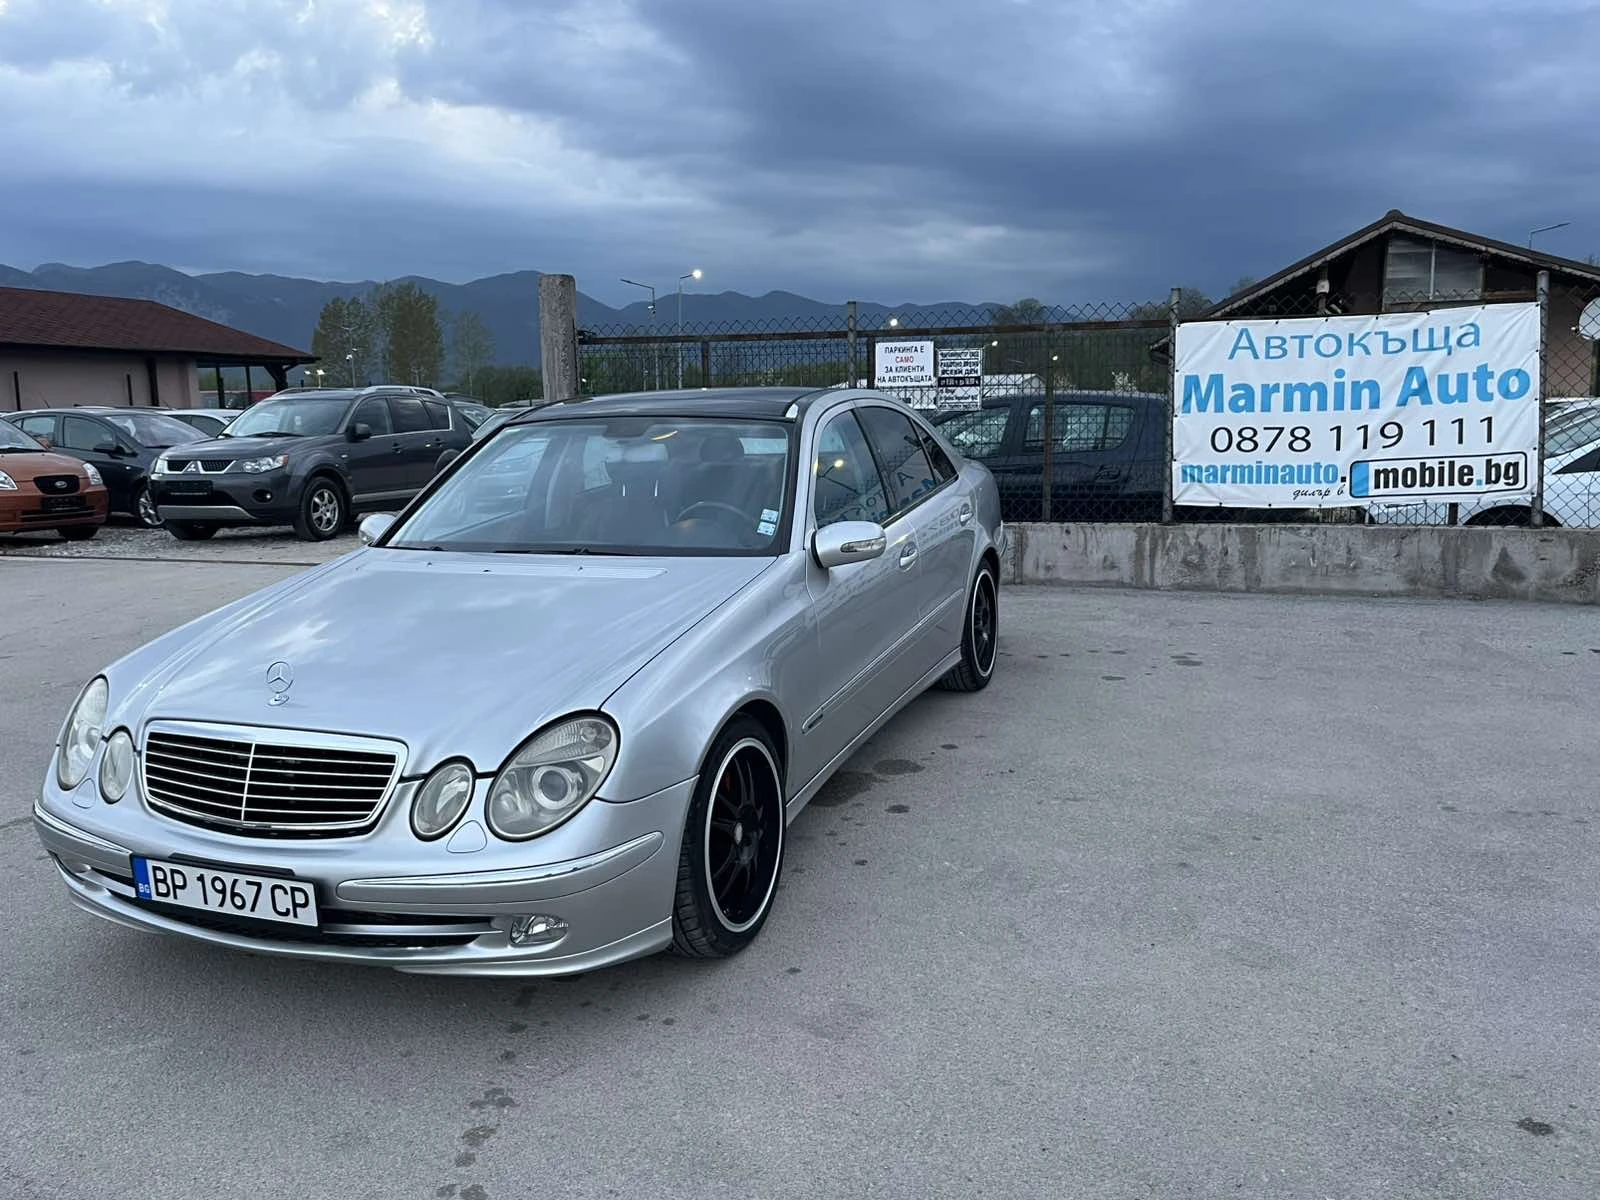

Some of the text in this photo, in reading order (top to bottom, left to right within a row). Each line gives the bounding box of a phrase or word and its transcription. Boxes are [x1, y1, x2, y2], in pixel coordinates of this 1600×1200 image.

[885, 345, 925, 354] ПАРКИНГА Е
[1228, 322, 1481, 360] Автокъща
[884, 365, 925, 374] ЗА КЛИЕНТИ
[895, 356, 914, 364] САМО
[1182, 362, 1531, 414] Marmin Auto
[1210, 416, 1493, 453] 0878 119 111
[1374, 458, 1520, 490] mobile.bg
[1292, 487, 1331, 500] дилър
[152, 865, 310, 919] BP 1967 CP
